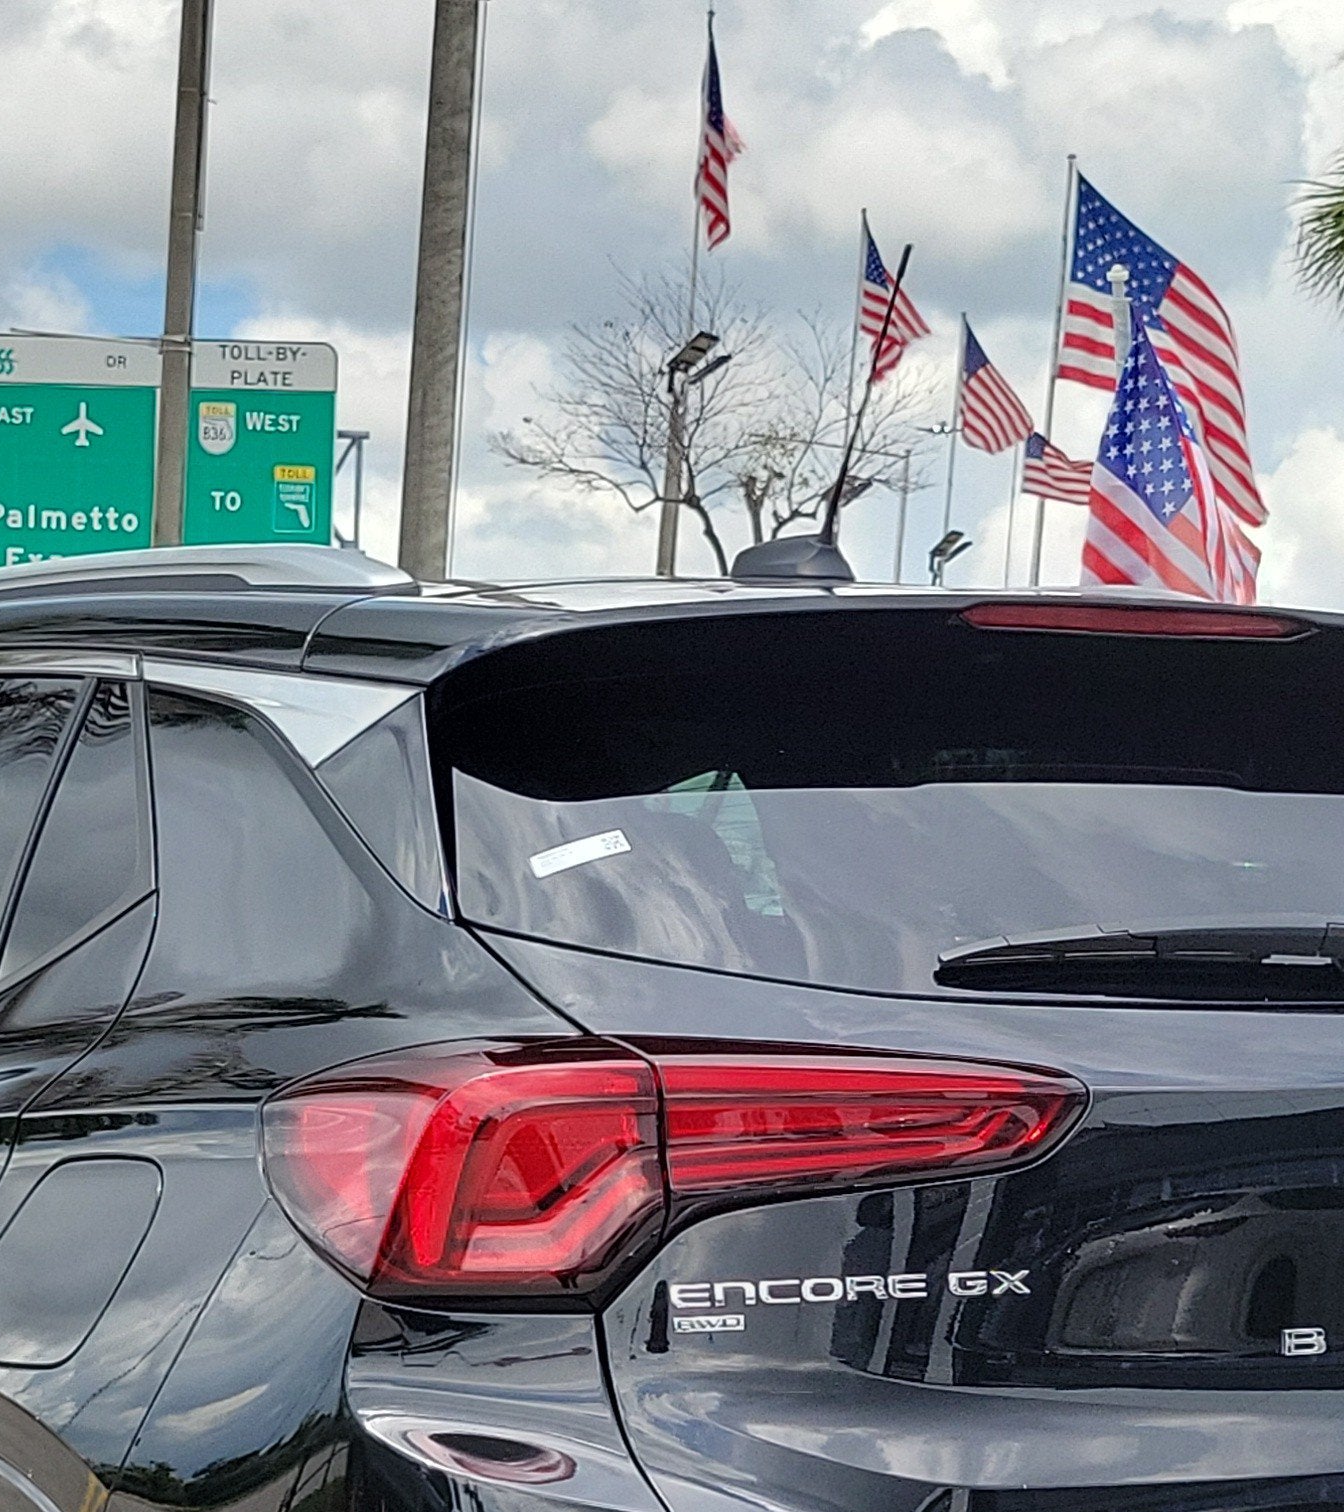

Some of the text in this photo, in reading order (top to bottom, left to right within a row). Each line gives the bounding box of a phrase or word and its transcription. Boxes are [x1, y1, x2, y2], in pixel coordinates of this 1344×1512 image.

[218, 344, 307, 361] TOLL-BY-
[229, 370, 293, 387] PLATE
[205, 405, 231, 416] TOLL
[245, 411, 301, 432] WEST
[203, 426, 227, 441] 836
[279, 467, 310, 479] TOLL
[211, 491, 242, 511] TO
[668, 1269, 1031, 1309] ENCORE GX
[676, 1317, 741, 1331] AWD
